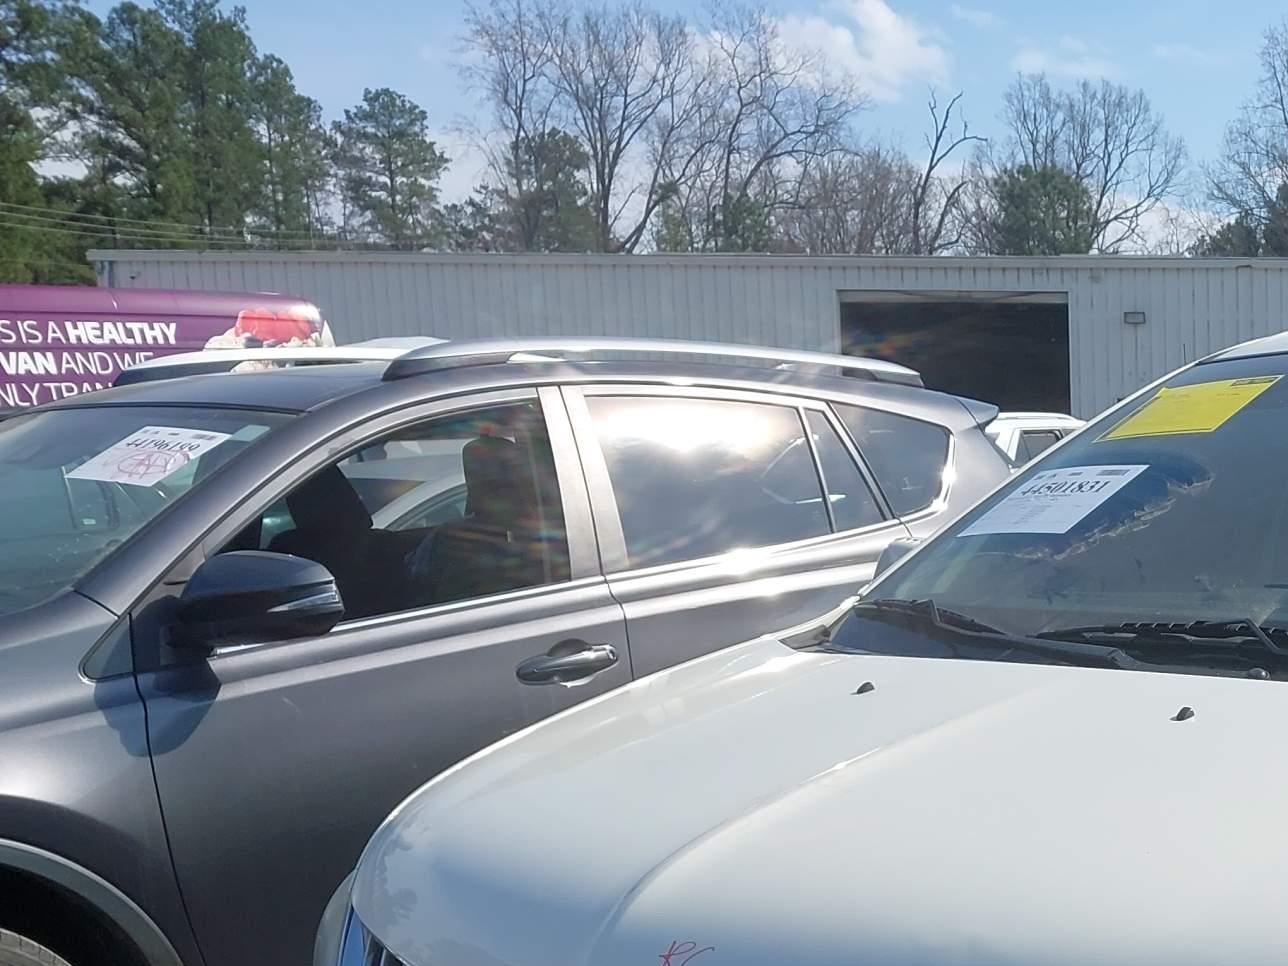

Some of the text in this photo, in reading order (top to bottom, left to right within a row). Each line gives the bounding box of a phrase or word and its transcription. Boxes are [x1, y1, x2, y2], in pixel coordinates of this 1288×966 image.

[17, 320, 42, 343] IS
[47, 321, 66, 343] A
[64, 321, 177, 345] HEALTHY
[0, 351, 58, 374] VAN
[61, 351, 113, 374] AND
[1021, 480, 1111, 496] 44501831
